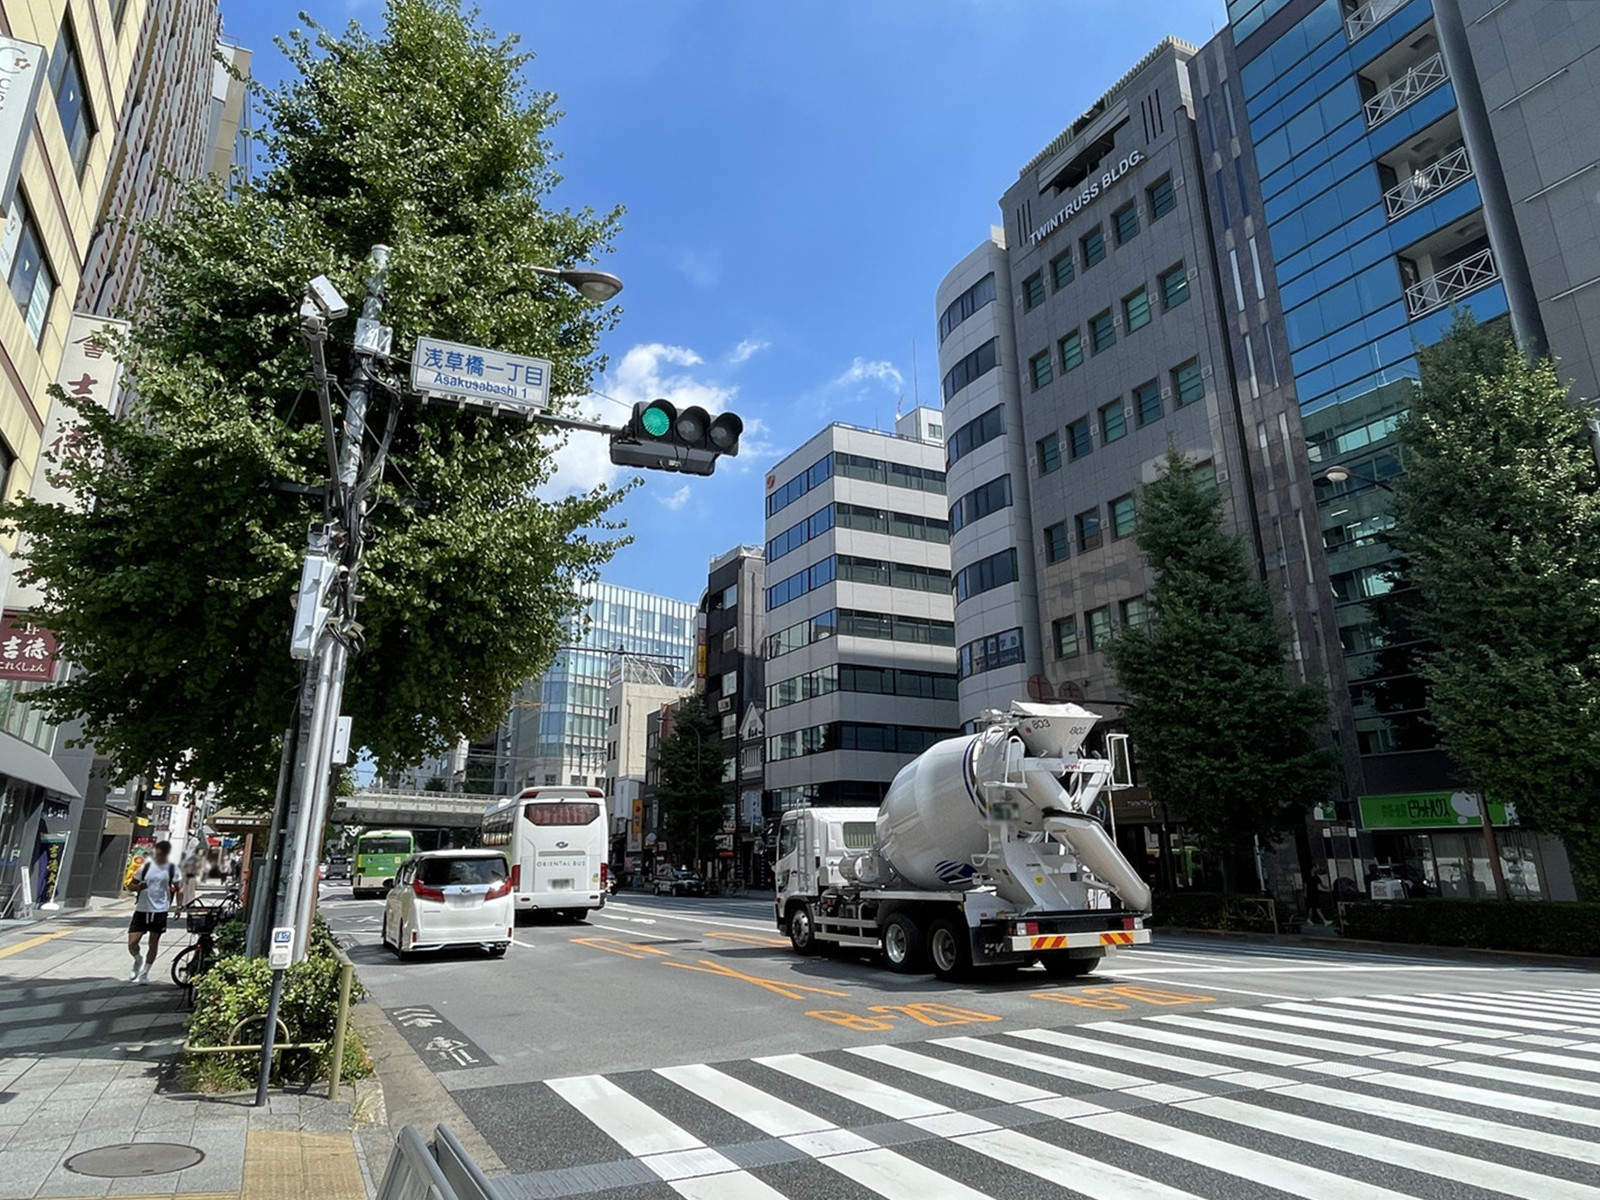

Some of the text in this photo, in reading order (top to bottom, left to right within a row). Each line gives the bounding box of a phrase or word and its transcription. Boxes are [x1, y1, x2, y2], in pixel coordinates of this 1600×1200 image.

[1029, 149, 1145, 246] TWINTRUSS BLDG.
[423, 347, 543, 387] 浅草橋一丁目
[434, 372, 527, 398] Asakusabashi 1
[2, 636, 49, 660] 吉徳
[1031, 719, 1050, 729] 803
